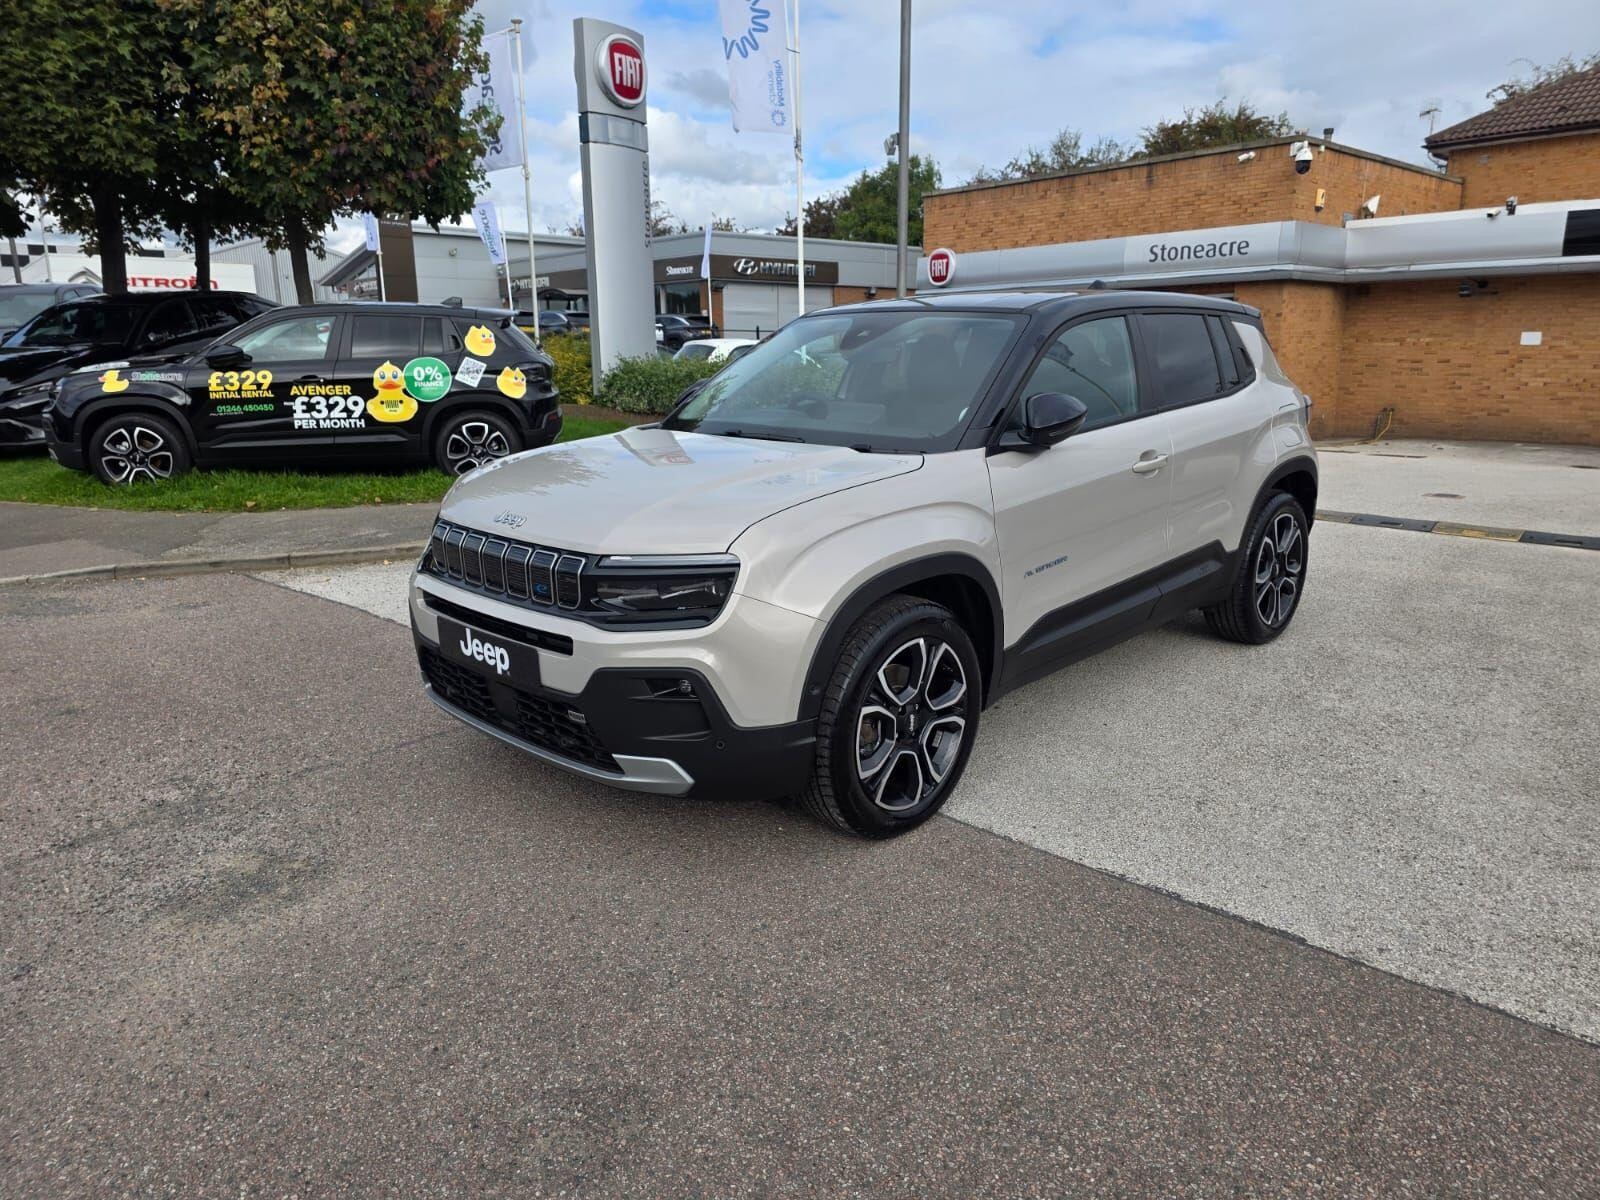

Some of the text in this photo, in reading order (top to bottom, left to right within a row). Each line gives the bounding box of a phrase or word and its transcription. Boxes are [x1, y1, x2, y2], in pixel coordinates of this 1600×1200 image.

[614, 52, 641, 90] FIAT
[1149, 238, 1250, 262] Stoneacre
[931, 258, 947, 277] FIAT
[208, 370, 273, 391] £329
[413, 366, 443, 381] 0%
[209, 390, 274, 399] INITIAL RENTAL
[290, 385, 352, 396] AVENGER
[217, 404, 274, 413] 01246 450450
[292, 396, 365, 419] £329
[294, 419, 365, 429] PER MONTH
[494, 511, 527, 529] Jeep
[459, 628, 509, 674] Jeep
